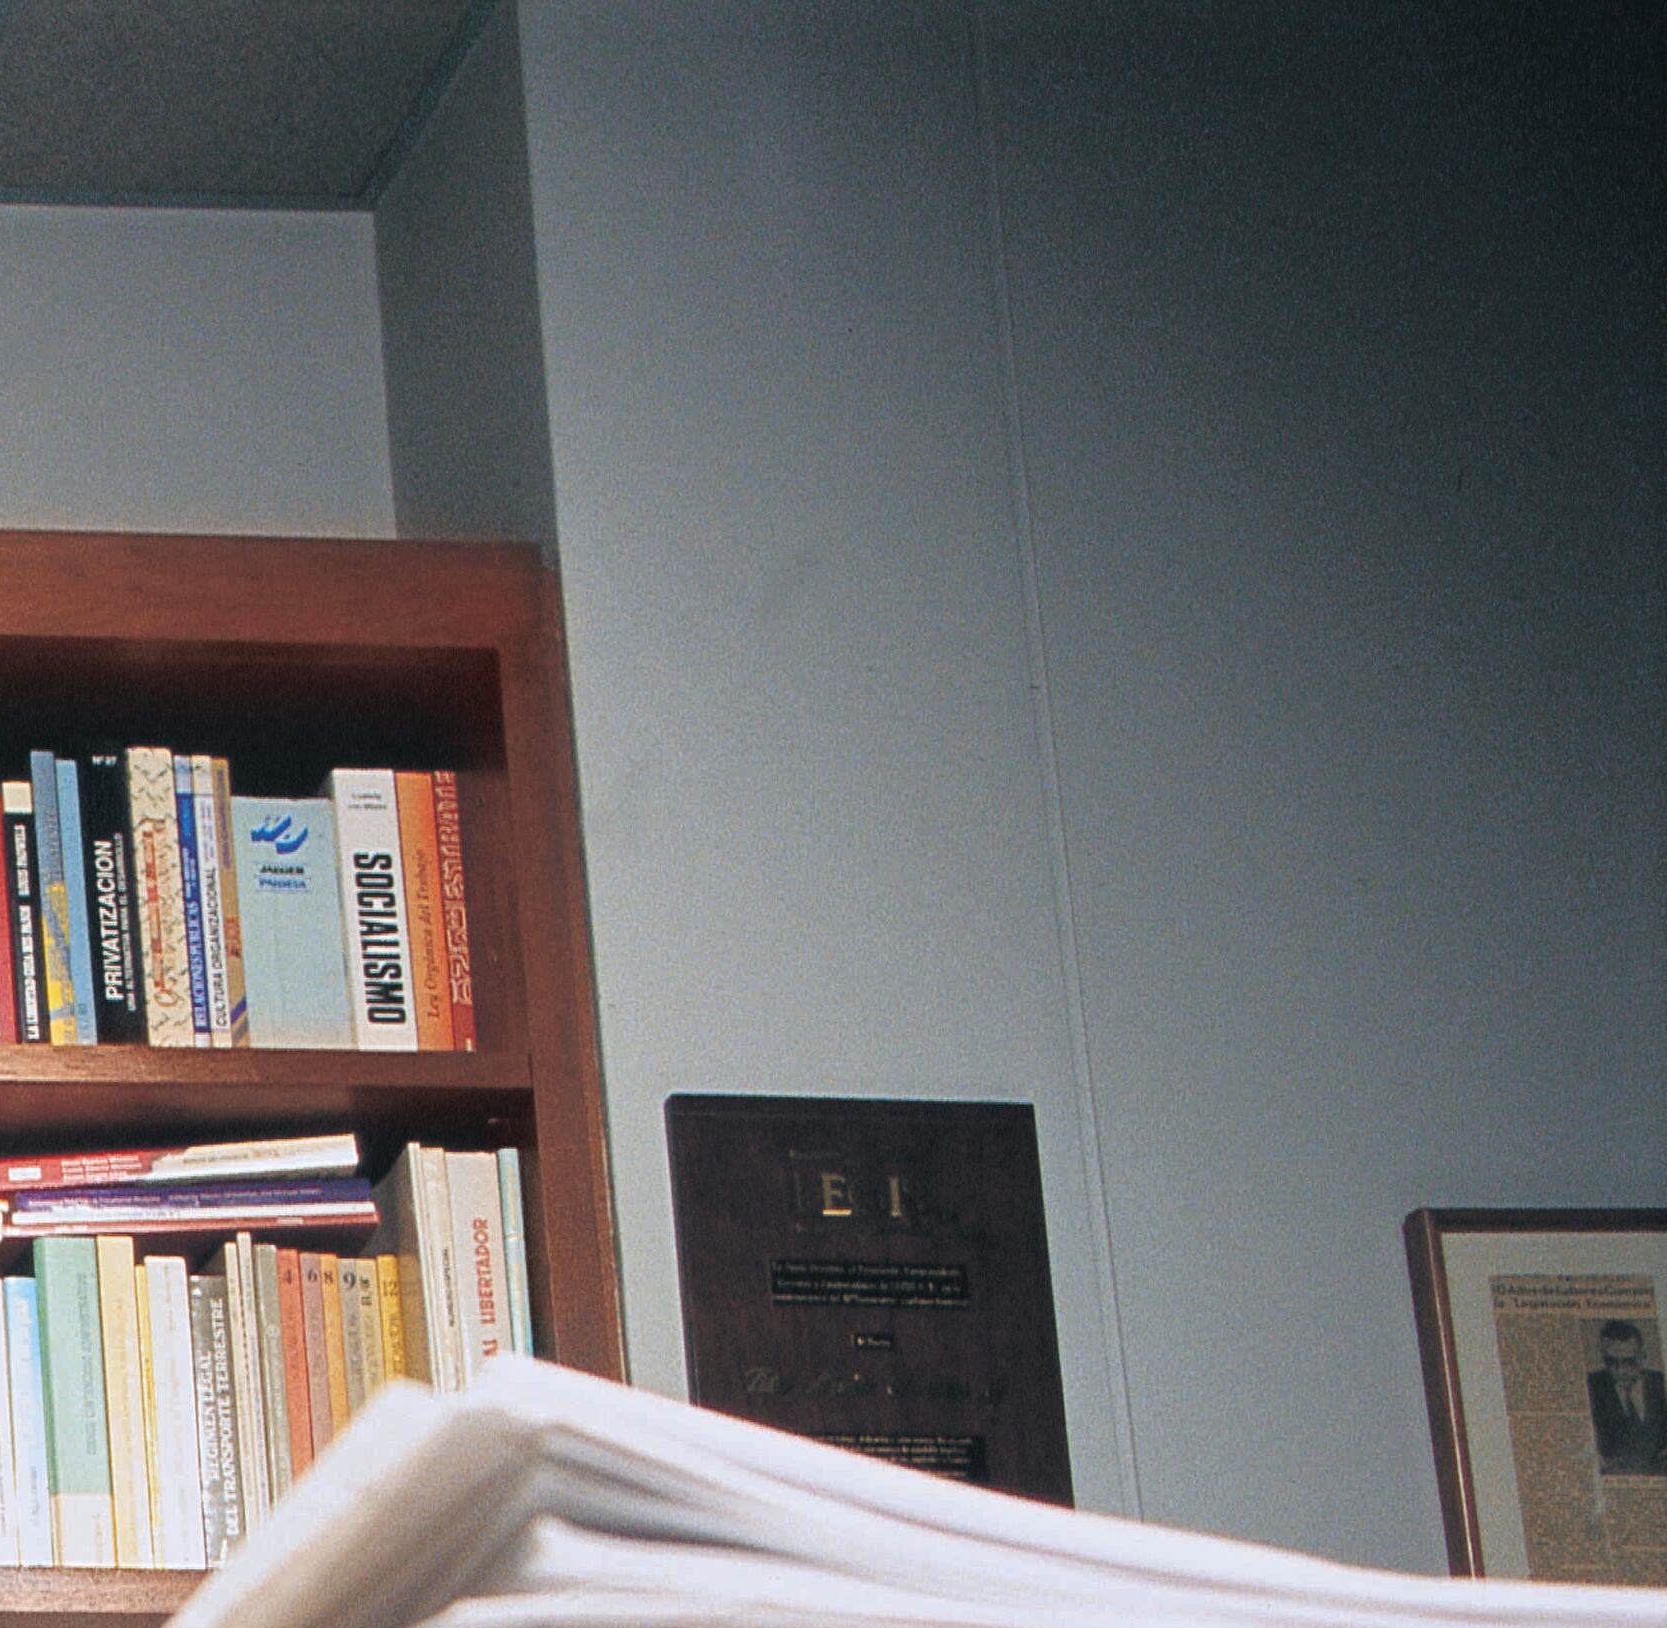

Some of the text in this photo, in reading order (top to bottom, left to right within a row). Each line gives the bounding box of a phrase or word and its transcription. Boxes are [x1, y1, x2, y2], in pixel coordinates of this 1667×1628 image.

[93, 840, 125, 1000] PRIVATIZACION
[206, 867, 228, 1027] CULTURA ORGANIZACIONAL
[352, 851, 406, 1025] SOCIALISMO
[307, 1269, 317, 1282] 6
[343, 1271, 357, 1289] 9
[472, 1218, 495, 1325] LIBERTADOR
[198, 1351, 215, 1403] LEGAL
[211, 1298, 240, 1536] DEL TRANSPORTE TERRESTRE
